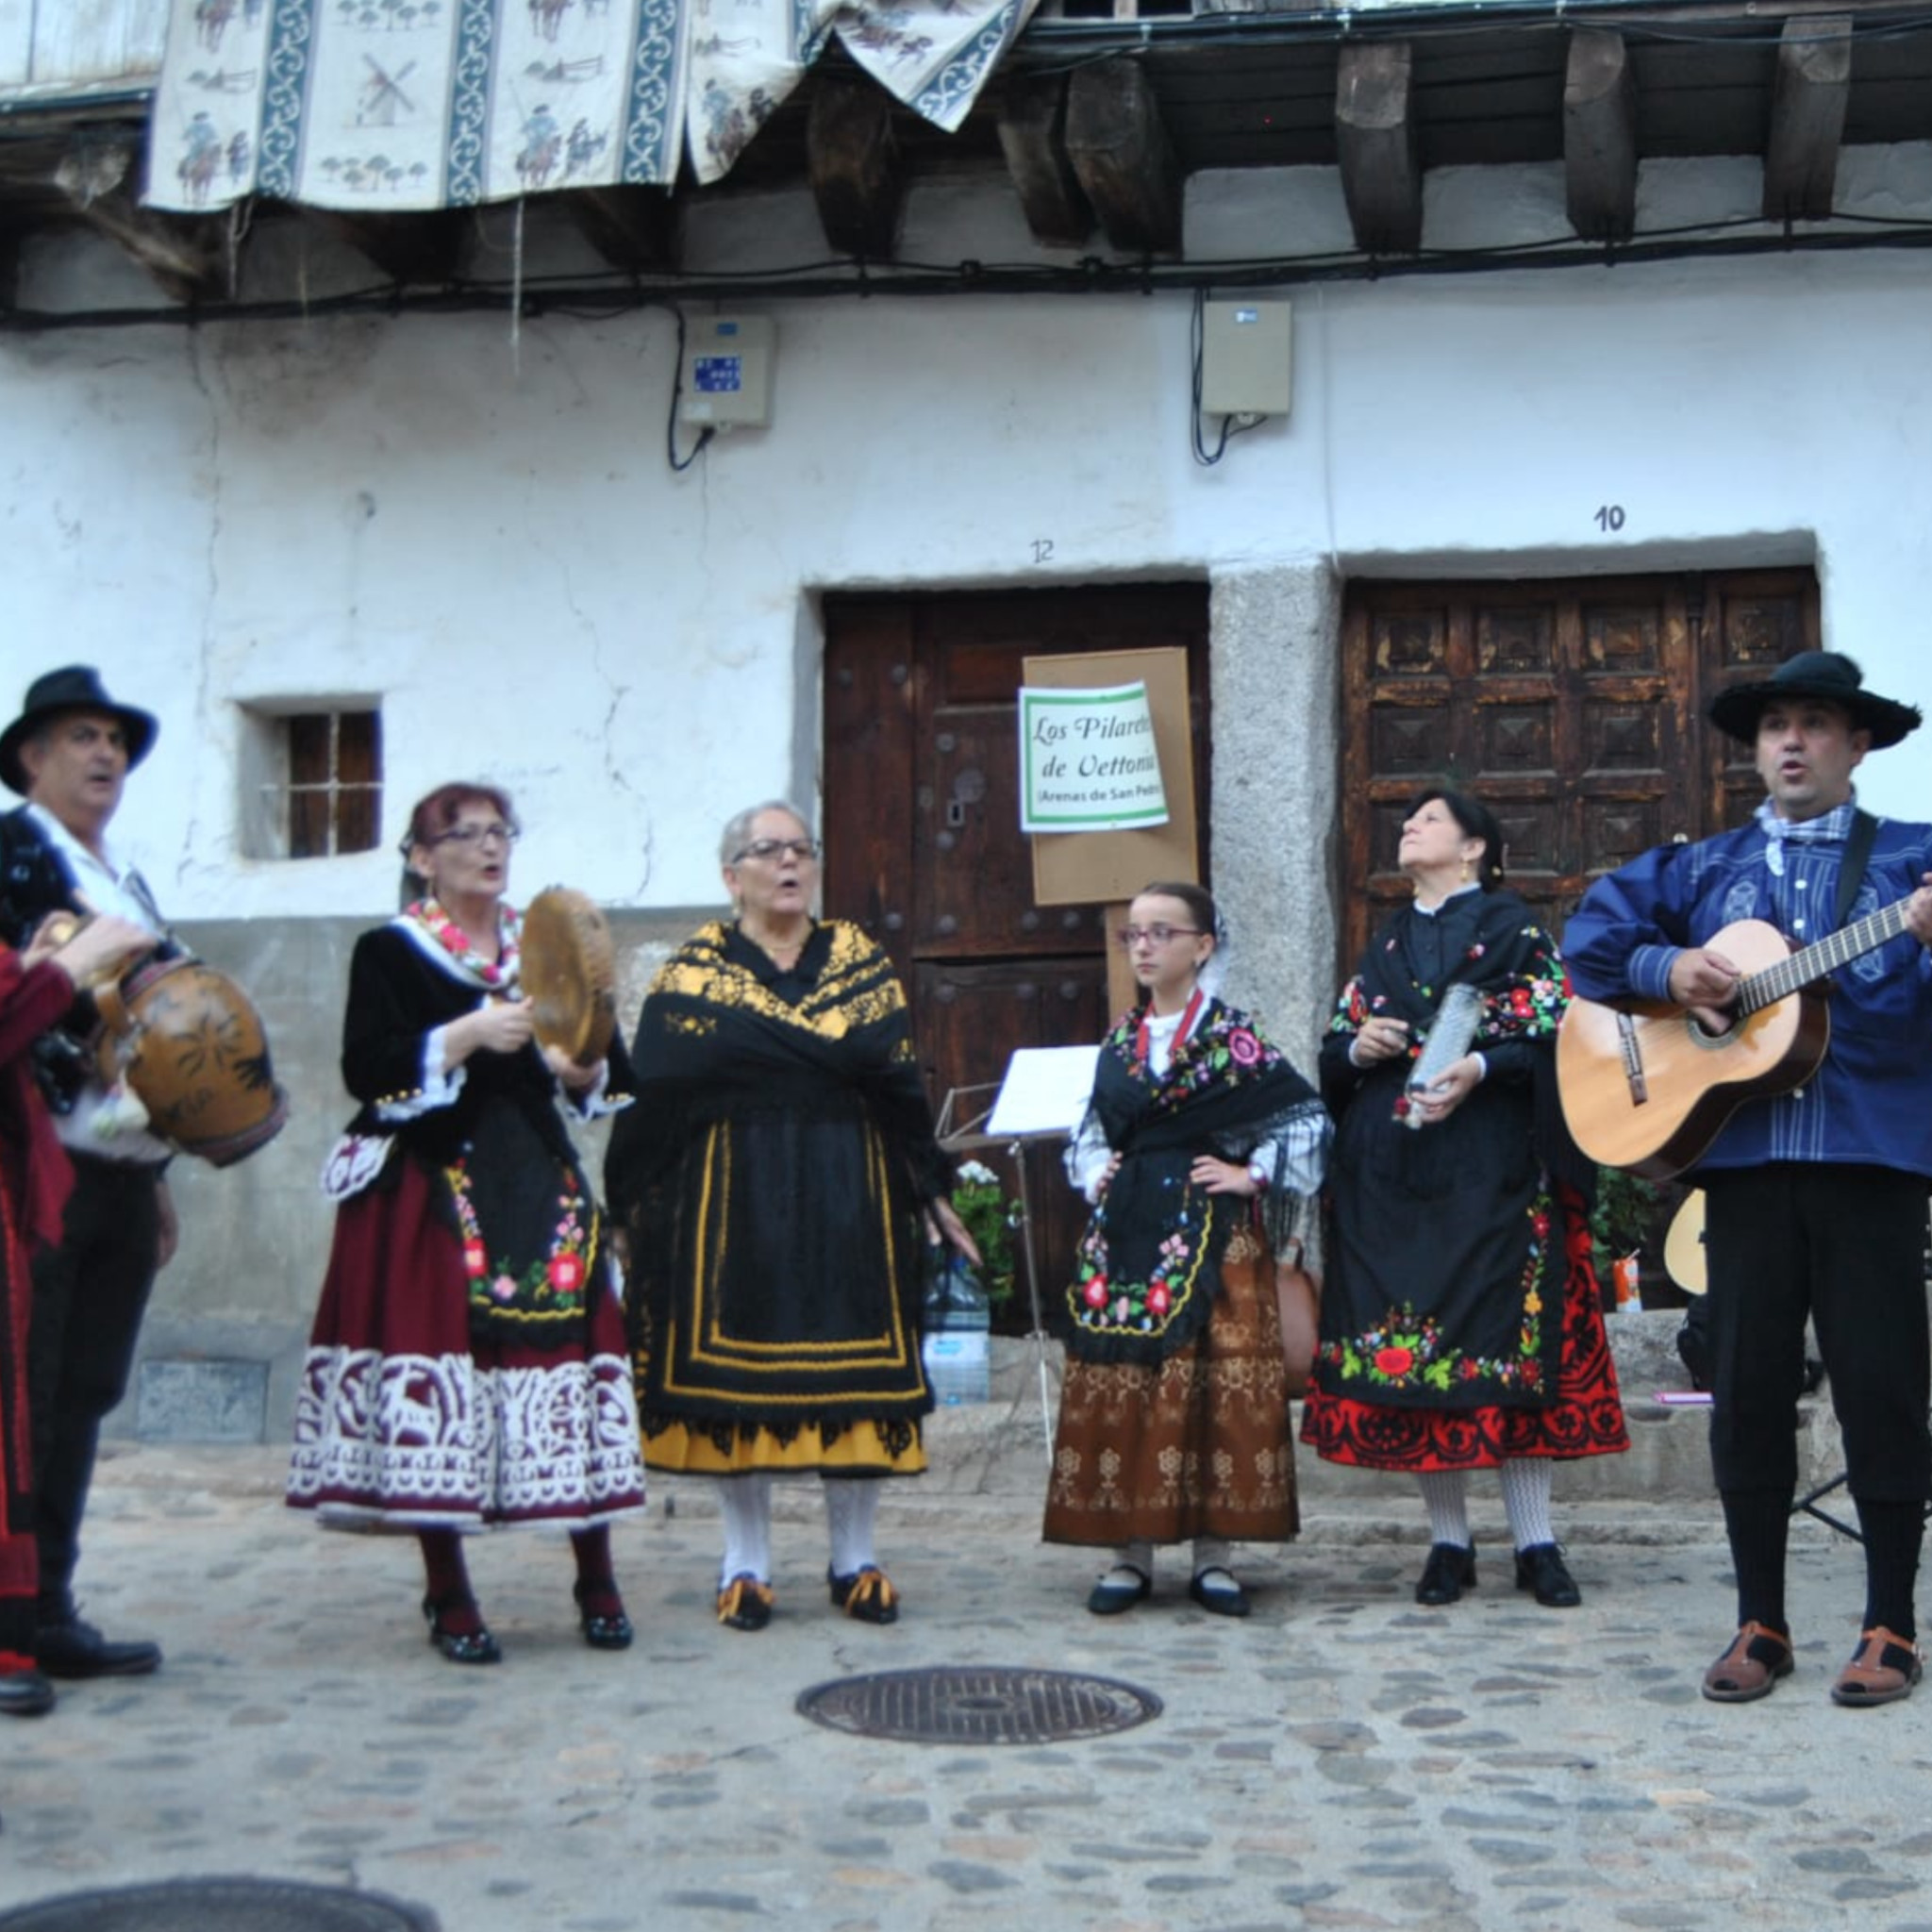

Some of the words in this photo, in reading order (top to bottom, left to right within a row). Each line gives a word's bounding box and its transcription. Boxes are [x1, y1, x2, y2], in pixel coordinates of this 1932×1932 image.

[1593, 505, 1625, 532] 10
[1030, 539, 1055, 563] 12
[1034, 717, 1068, 746] Los
[1042, 755, 1067, 777] de
[1090, 789, 1108, 802] de
[1110, 787, 1135, 801] San
